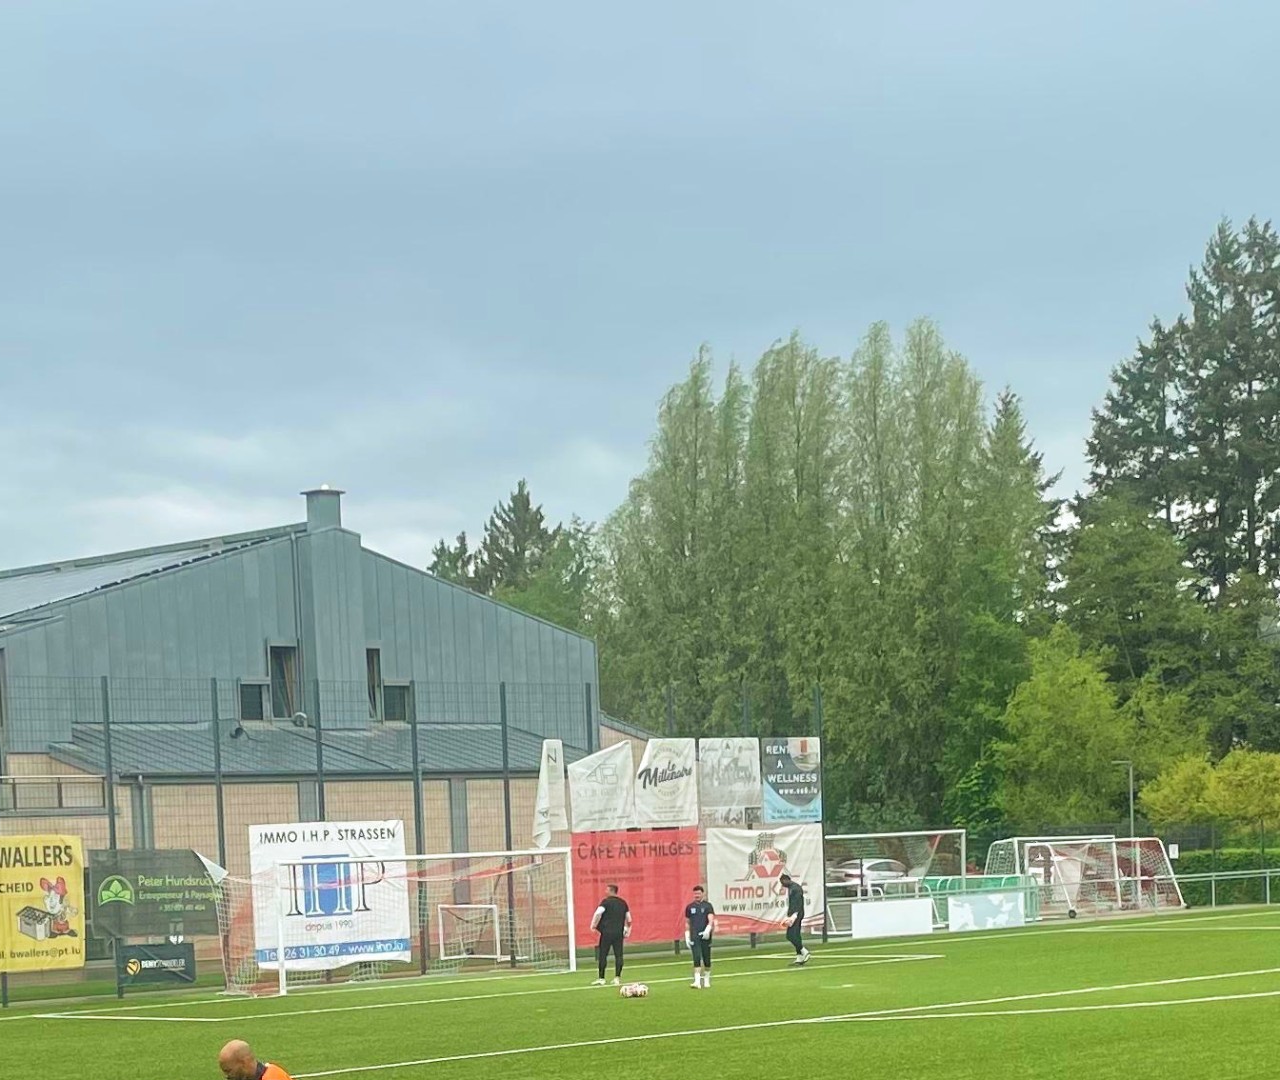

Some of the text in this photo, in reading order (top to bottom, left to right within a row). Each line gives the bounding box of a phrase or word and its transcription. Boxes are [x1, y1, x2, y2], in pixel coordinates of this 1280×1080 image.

[767, 773, 817, 783] WELLNESS
[260, 827, 396, 844] IMMO I.H.P. STRASSEN
[640, 840, 694, 859] THILGES
[138, 875, 163, 887] Peter
[285, 855, 385, 917] IHP
[724, 883, 765, 899] Immo
[305, 919, 354, 934] depuis 1990
[285, 948, 297, 960] 26
[299, 947, 310, 958] 31
[314, 945, 326, 957] 30
[329, 944, 340, 955] 49
